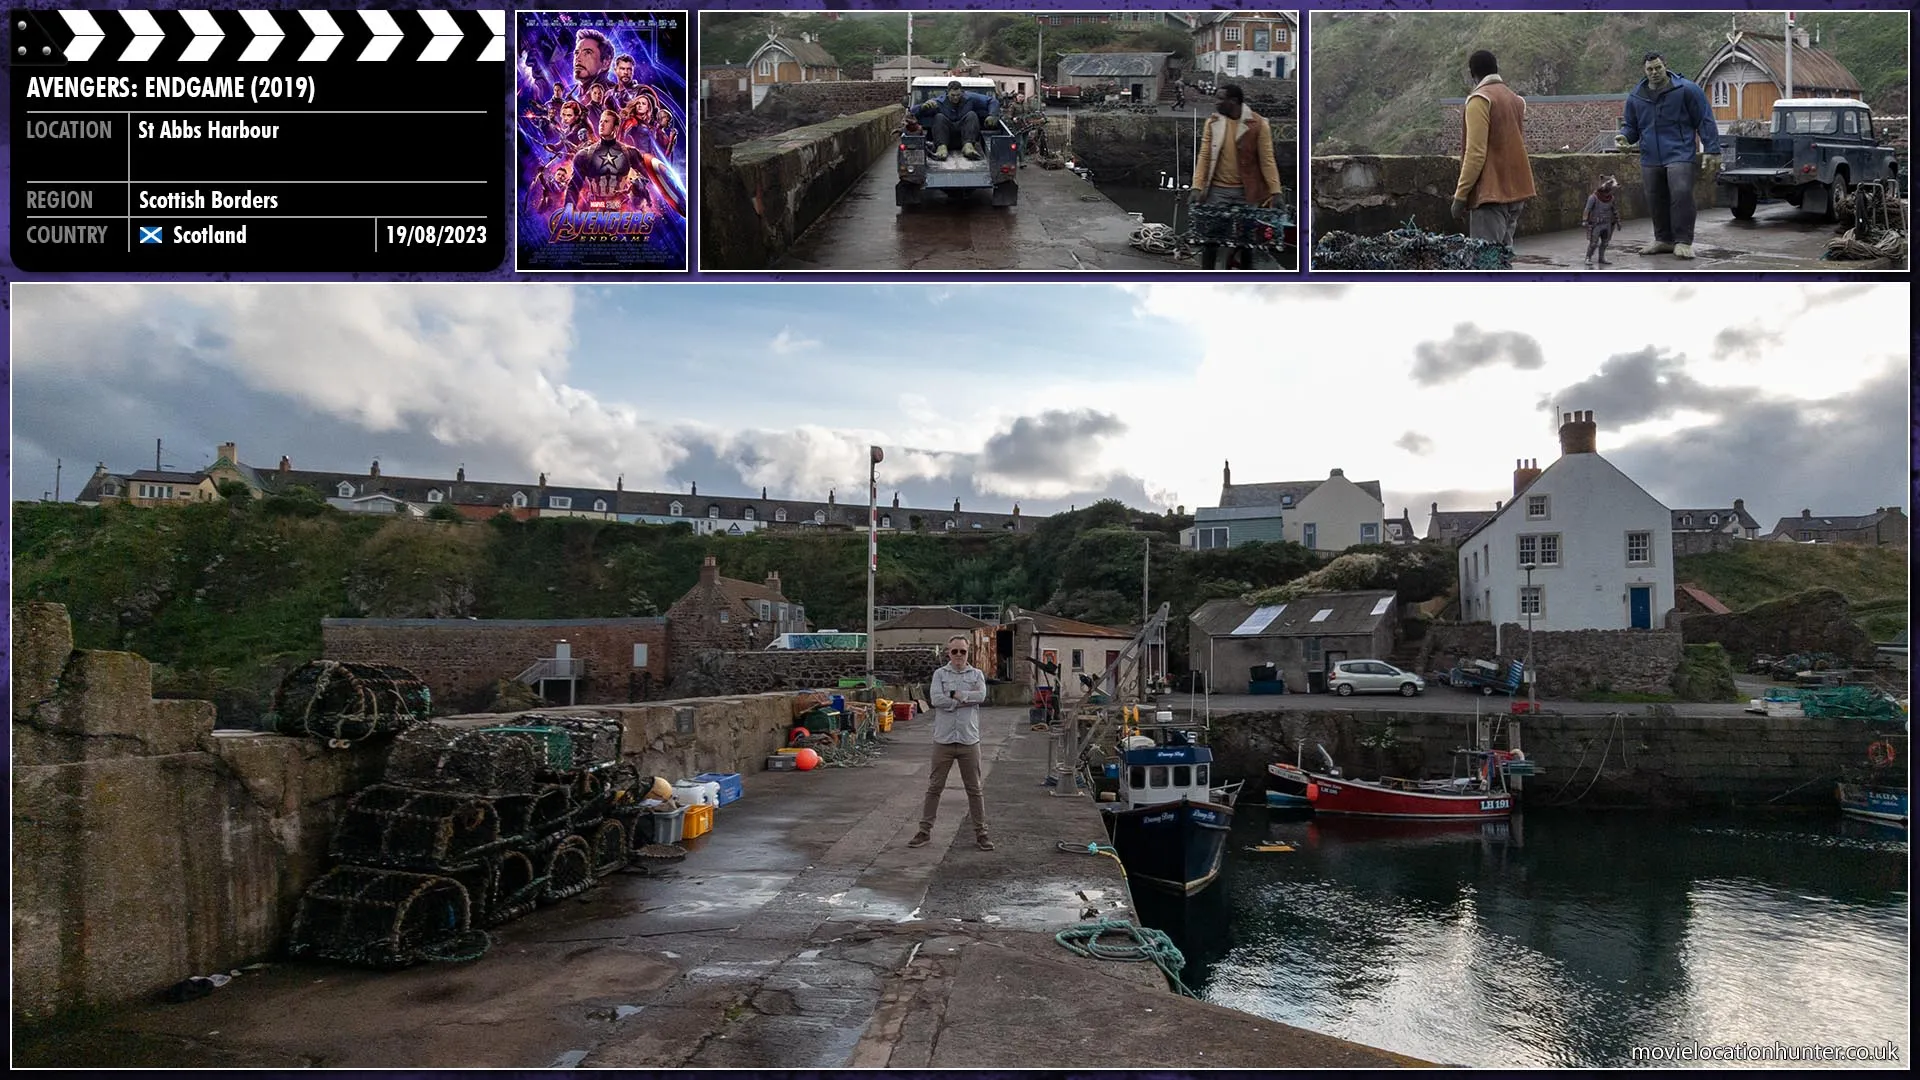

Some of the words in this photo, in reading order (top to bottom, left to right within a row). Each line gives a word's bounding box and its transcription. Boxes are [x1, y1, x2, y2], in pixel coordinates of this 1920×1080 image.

[548, 203, 655, 243] AVENGERS
[1480, 800, 1494, 810] LH
[1494, 799, 1509, 810] 191
